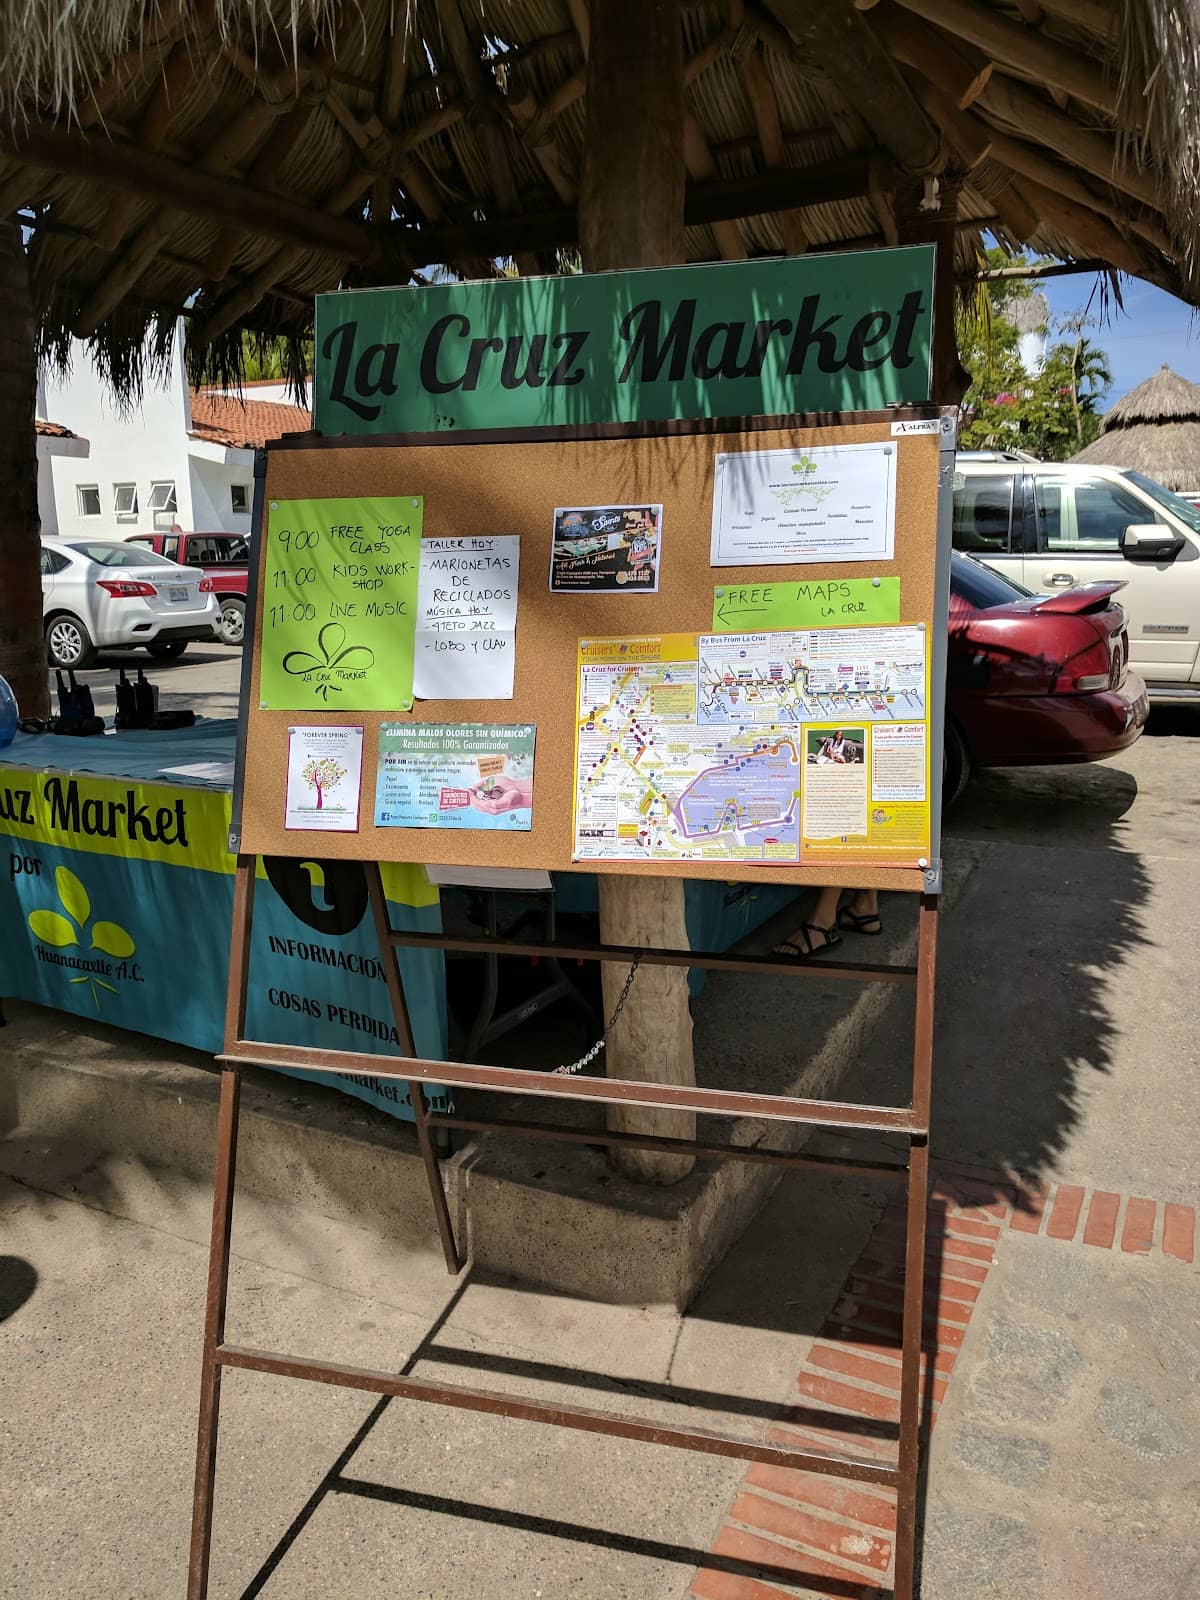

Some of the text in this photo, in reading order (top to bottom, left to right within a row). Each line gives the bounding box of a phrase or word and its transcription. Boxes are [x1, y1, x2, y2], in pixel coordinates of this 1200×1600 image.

[322, 290, 926, 422] La Cruz Market
[329, 525, 412, 540] FREE YOGA
[278, 530, 320, 553] 9:00
[349, 541, 392, 554] CLASS
[429, 538, 494, 549] TALLER HOY
[333, 563, 369, 577] KIDS
[273, 567, 317, 588] 11:00
[351, 578, 385, 591] SHOP
[451, 575, 471, 587] DE
[433, 588, 512, 602] RECICLADOS
[728, 582, 851, 605] FREE MAPS
[270, 603, 317, 629] 11:00
[329, 601, 409, 618] LIVE MUSIC
[467, 605, 490, 616] HOY
[820, 606, 836, 617] LA
[469, 620, 496, 631] JAZZ
[701, 637, 709, 645] By
[630, 643, 661, 654] Comfort
[617, 665, 644, 673] Cruisers
[386, 728, 417, 737] ELIMINA
[418, 728, 444, 737] MALOS
[446, 728, 474, 737] OLORES
[475, 729, 488, 737] SIN
[402, 739, 509, 750] Resultados 100% Garantizados
[0, 777, 189, 848] uz Market
[10, 851, 42, 881] por
[268, 935, 388, 984] INFORMACIÓN
[115, 960, 145, 982] A.C.
[268, 987, 401, 1047] COSAS PERDIDA
